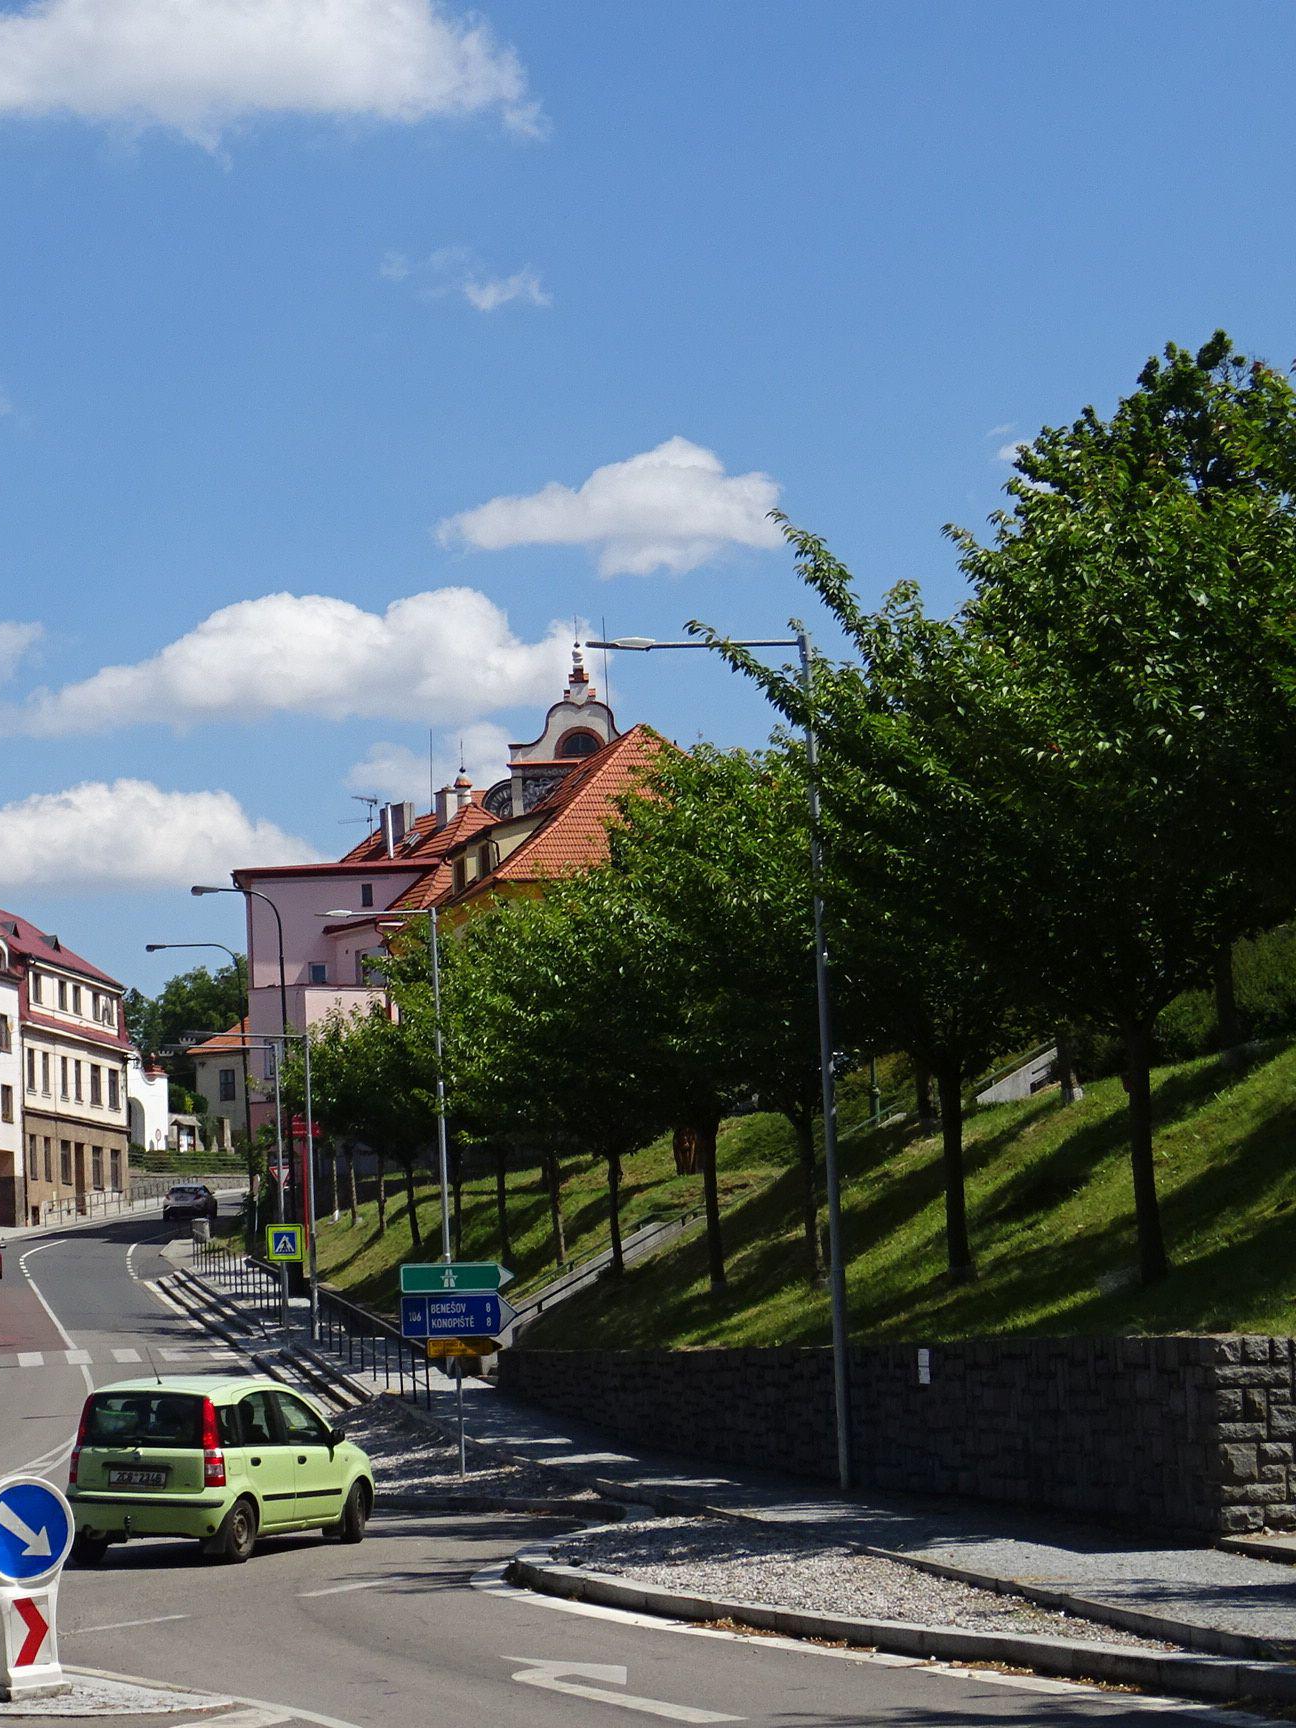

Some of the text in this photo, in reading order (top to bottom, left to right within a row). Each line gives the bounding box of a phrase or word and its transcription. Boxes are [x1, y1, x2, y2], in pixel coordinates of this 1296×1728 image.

[430, 1301, 491, 1314] BENEŠOV 8
[408, 1312, 422, 1322] 106
[431, 1315, 492, 1328] KONOPIŠTĚ 8
